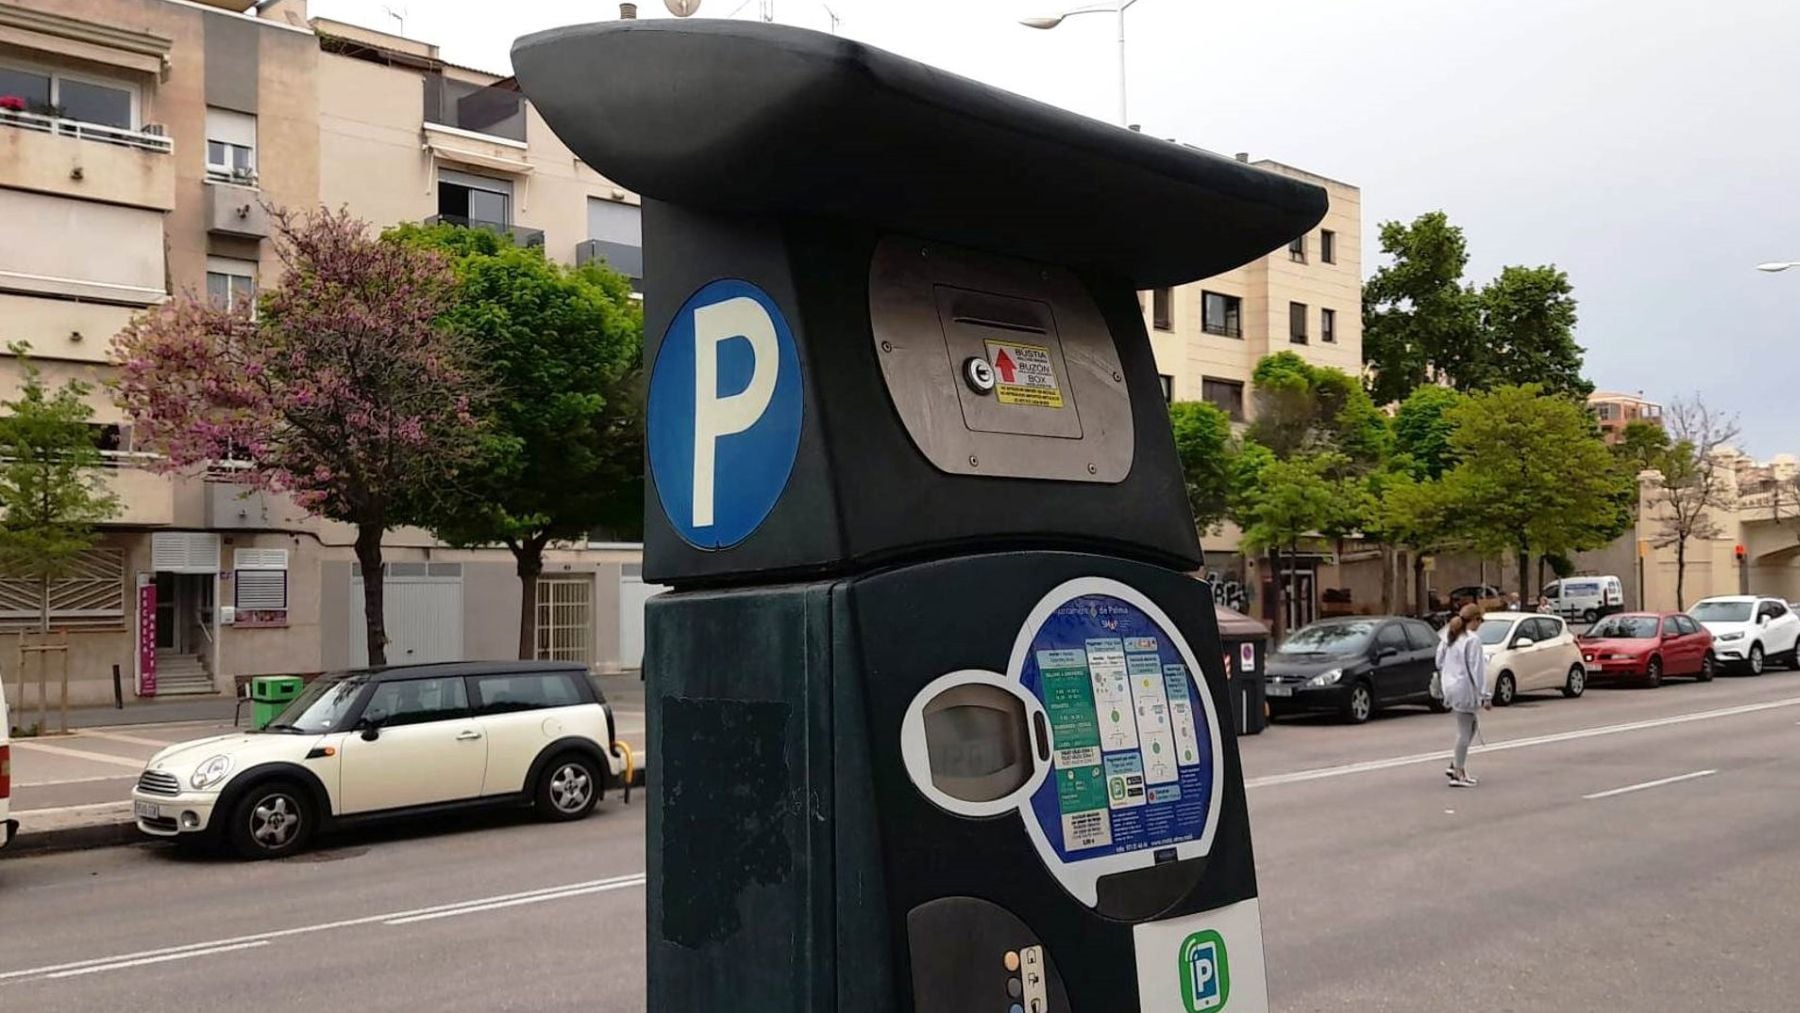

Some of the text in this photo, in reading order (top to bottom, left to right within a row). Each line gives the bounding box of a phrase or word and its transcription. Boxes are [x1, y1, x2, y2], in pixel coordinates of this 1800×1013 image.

[1015, 349, 1047, 358] BUSTIA
[1019, 362, 1050, 373] BUZÓN
[1028, 375, 1046, 383] BOX
[692, 296, 780, 528] P
[1195, 958, 1213, 993] P
